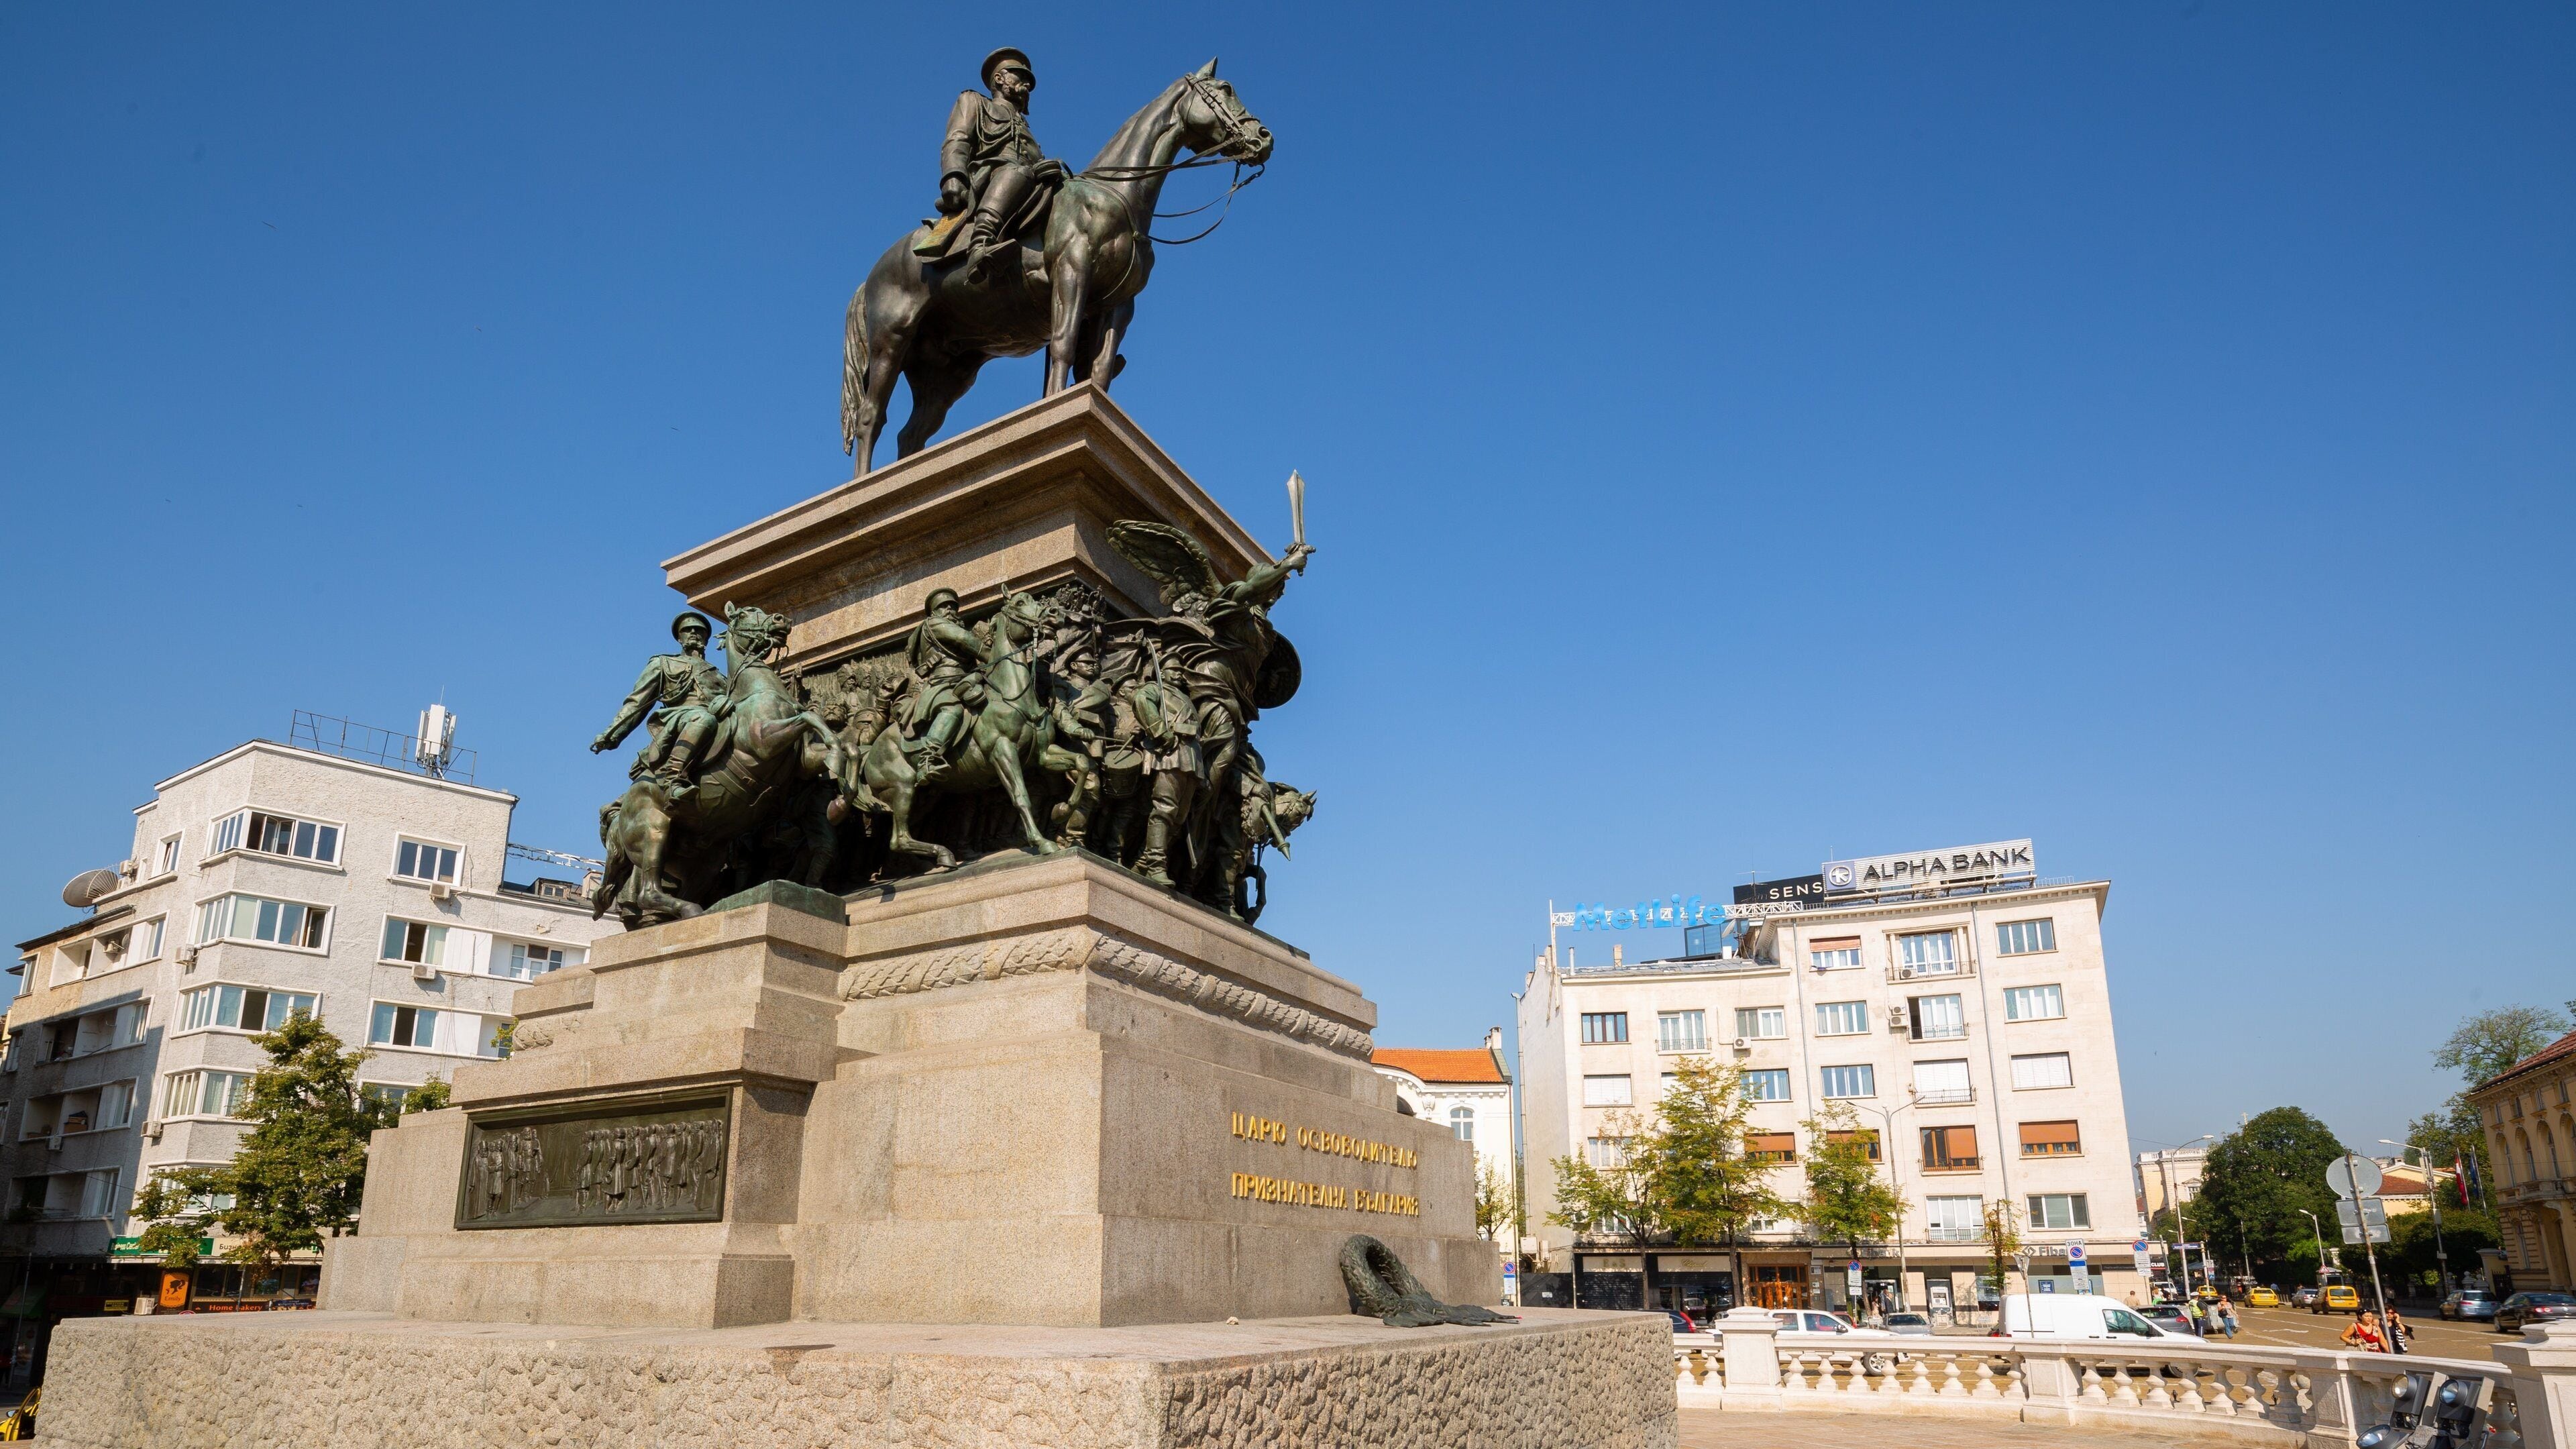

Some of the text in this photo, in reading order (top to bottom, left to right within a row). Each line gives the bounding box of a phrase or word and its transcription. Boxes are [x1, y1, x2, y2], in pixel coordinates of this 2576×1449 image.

[1864, 847, 2031, 882] ALPHA BANK
[1769, 881, 1823, 900] SENS
[1573, 894, 1726, 931] MetLife
[1232, 1112, 1417, 1169] ЦАРЮ ОСВОБОДИТЕЛЮ
[1232, 1172, 1419, 1217] ПРИЗНАТЕЛНА БЪЛГАРИЯ
[2039, 1246, 2068, 1256] Fiba
